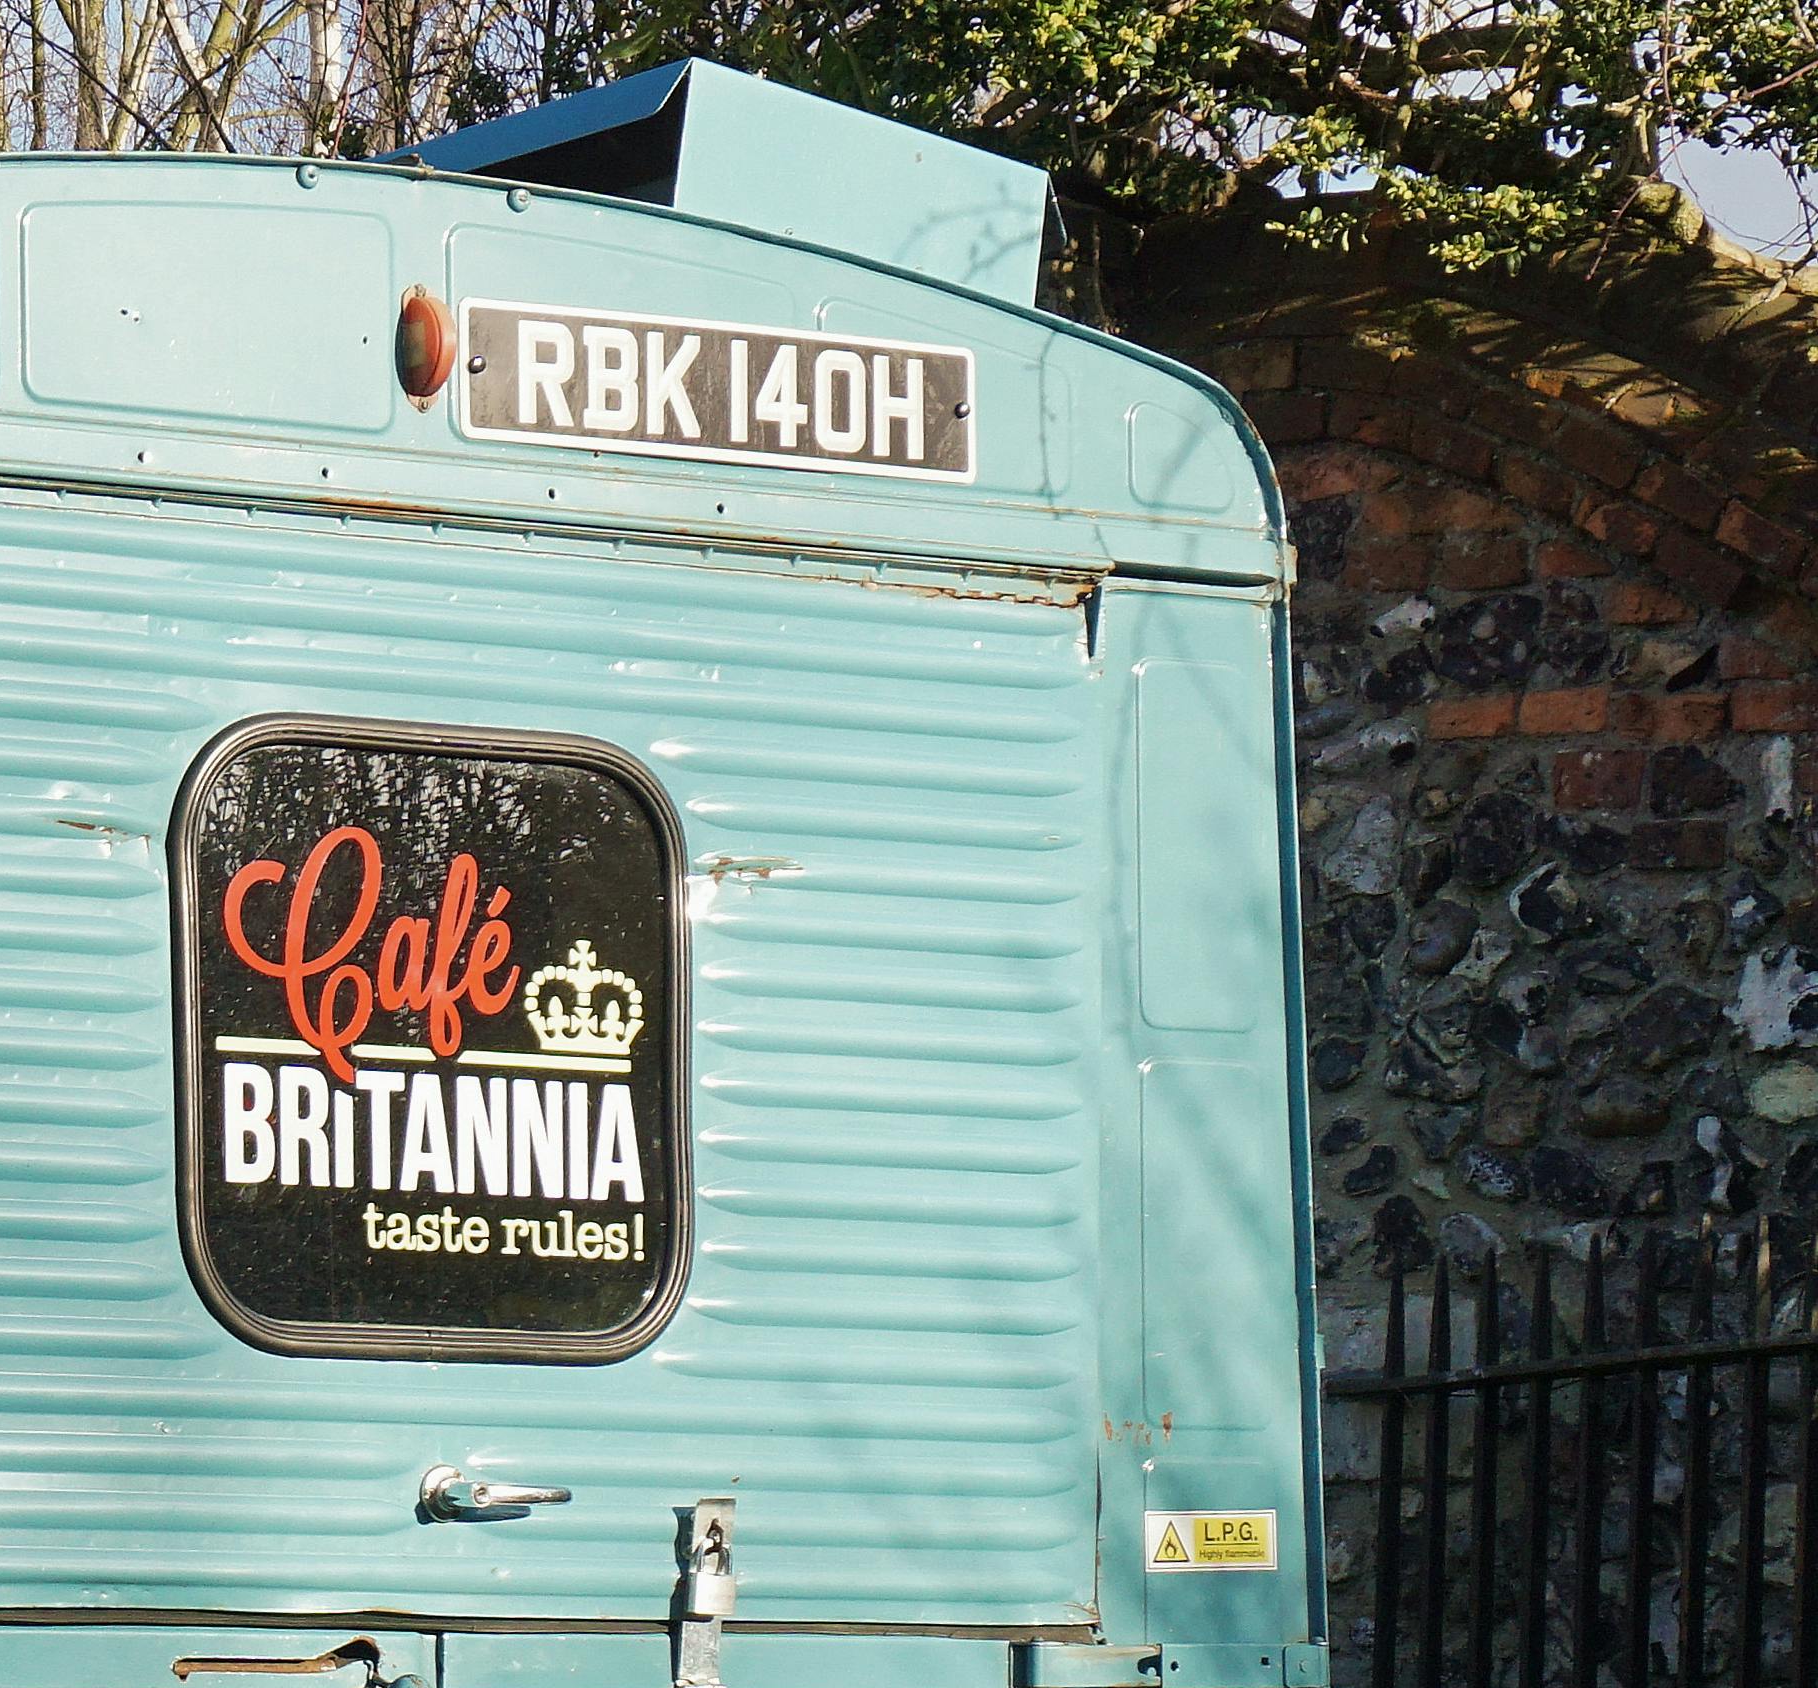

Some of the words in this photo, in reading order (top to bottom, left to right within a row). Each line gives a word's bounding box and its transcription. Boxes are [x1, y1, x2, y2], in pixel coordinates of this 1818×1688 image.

[517, 319, 702, 439] RBK
[729, 338, 925, 461] 140H
[222, 825, 520, 1084] Café
[223, 1061, 645, 1203] BRITANNIA
[363, 1202, 490, 1255] taste
[502, 1210, 646, 1263] rules!
[1204, 1521, 1258, 1541] L.P.G.
